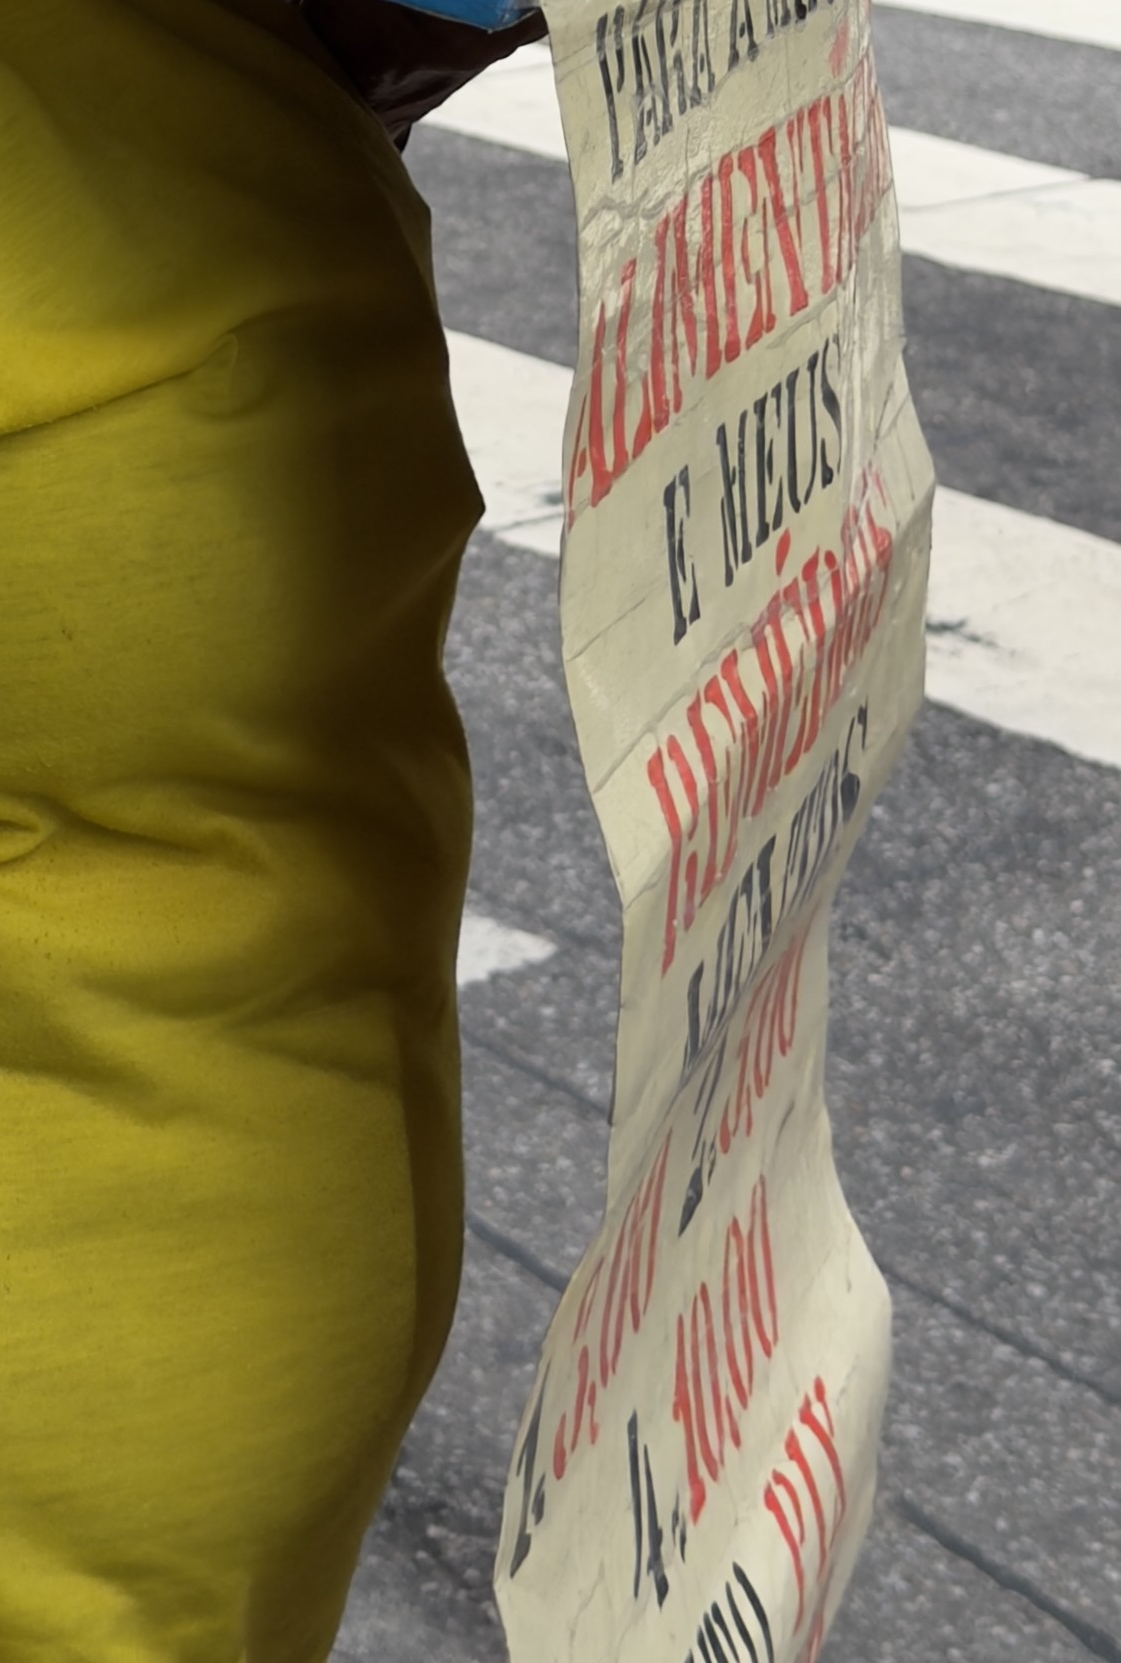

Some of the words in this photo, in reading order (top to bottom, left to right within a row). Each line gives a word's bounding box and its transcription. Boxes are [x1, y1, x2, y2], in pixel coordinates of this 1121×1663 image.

[663, 464, 702, 645] E
[716, 336, 842, 588] MEUS
[673, 1173, 779, 1525] 10,00
